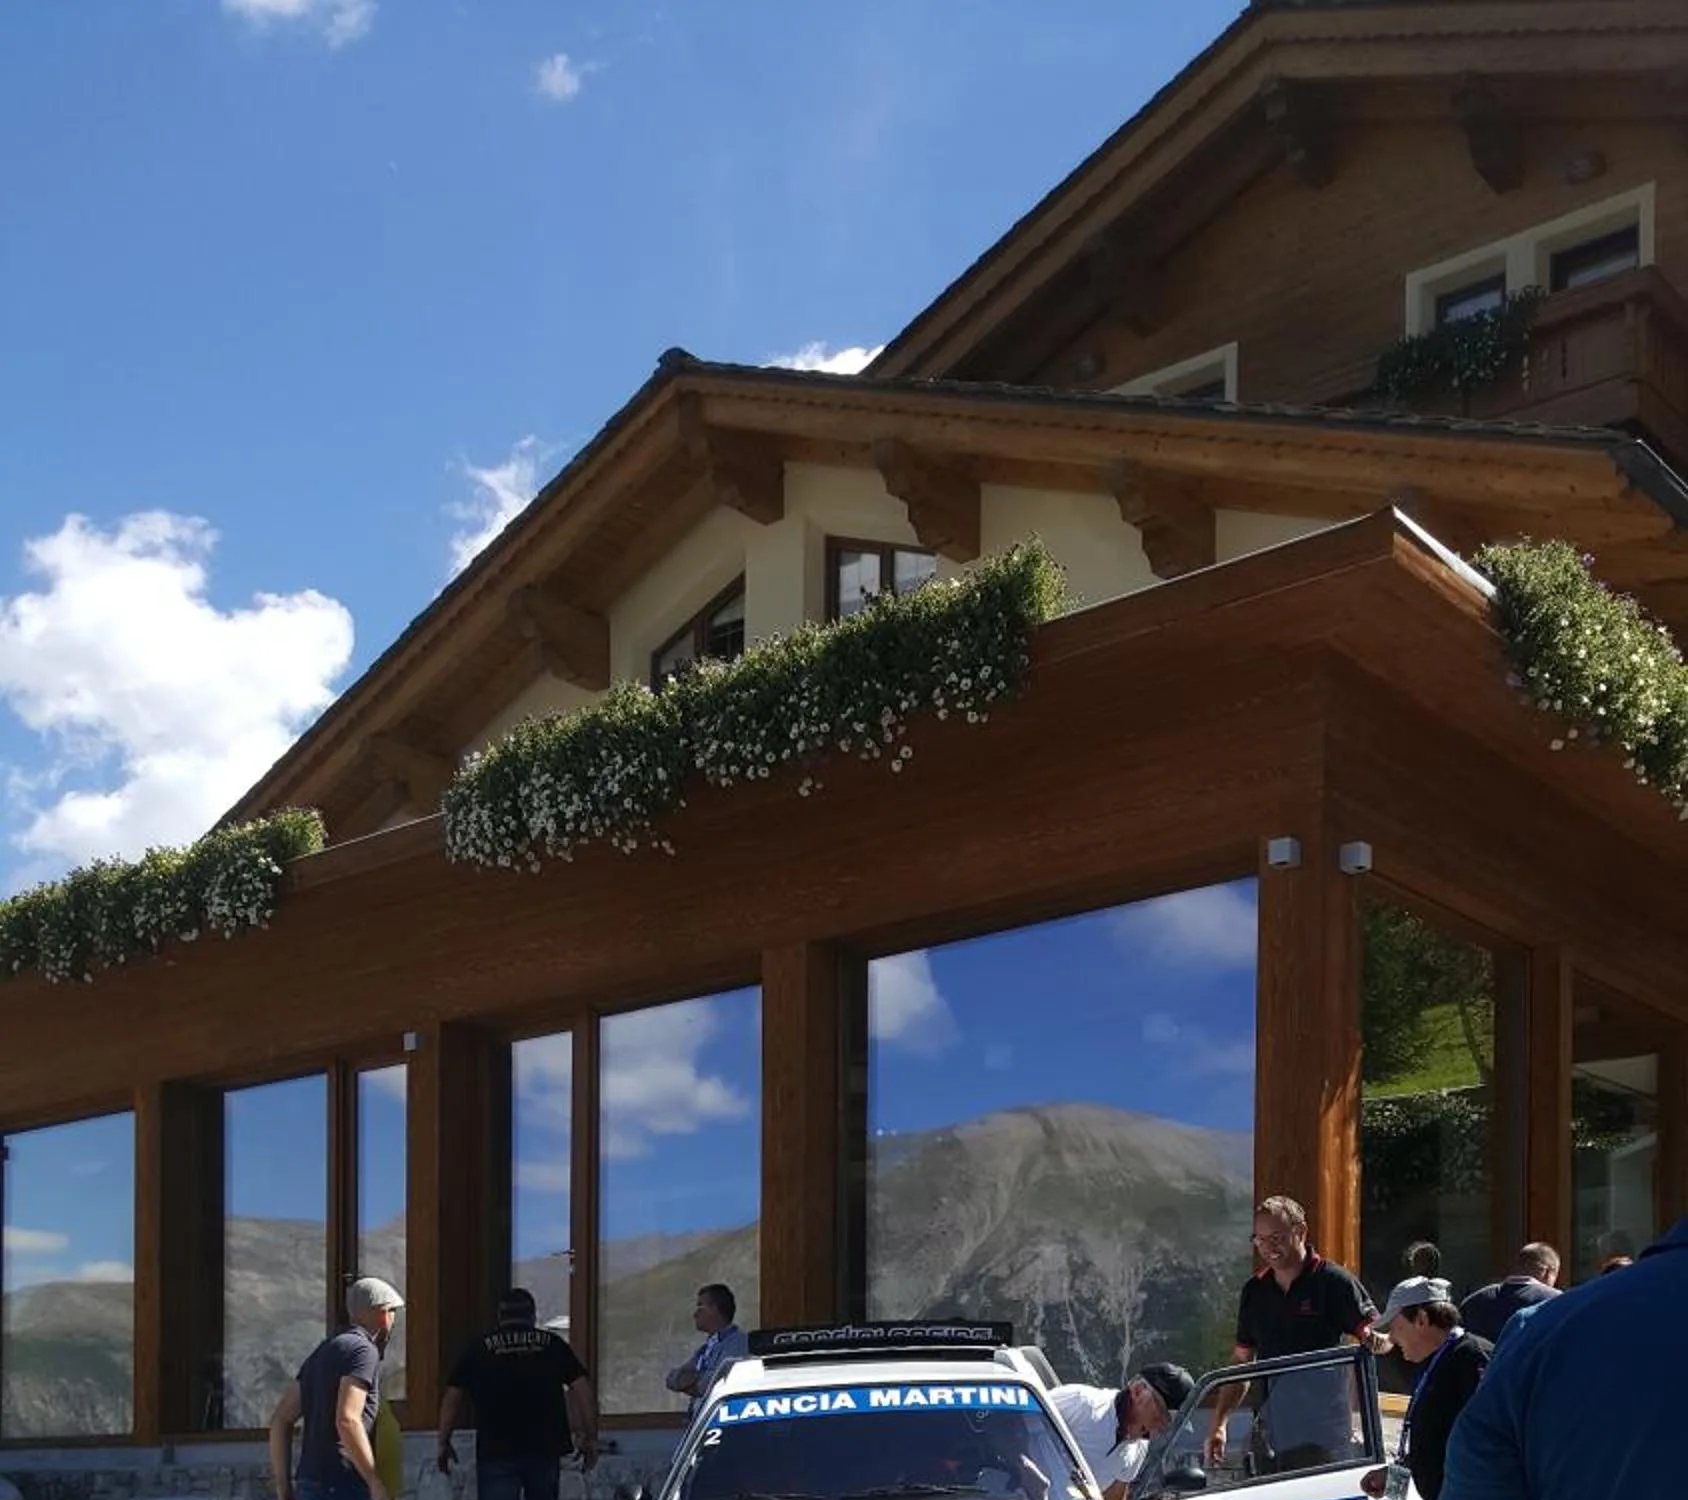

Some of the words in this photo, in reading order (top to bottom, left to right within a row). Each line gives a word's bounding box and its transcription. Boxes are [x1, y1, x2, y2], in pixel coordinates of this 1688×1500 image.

[719, 1393, 857, 1422] LANCIA
[869, 1387, 1028, 1406] MARTINI
[703, 1428, 721, 1446] 2
